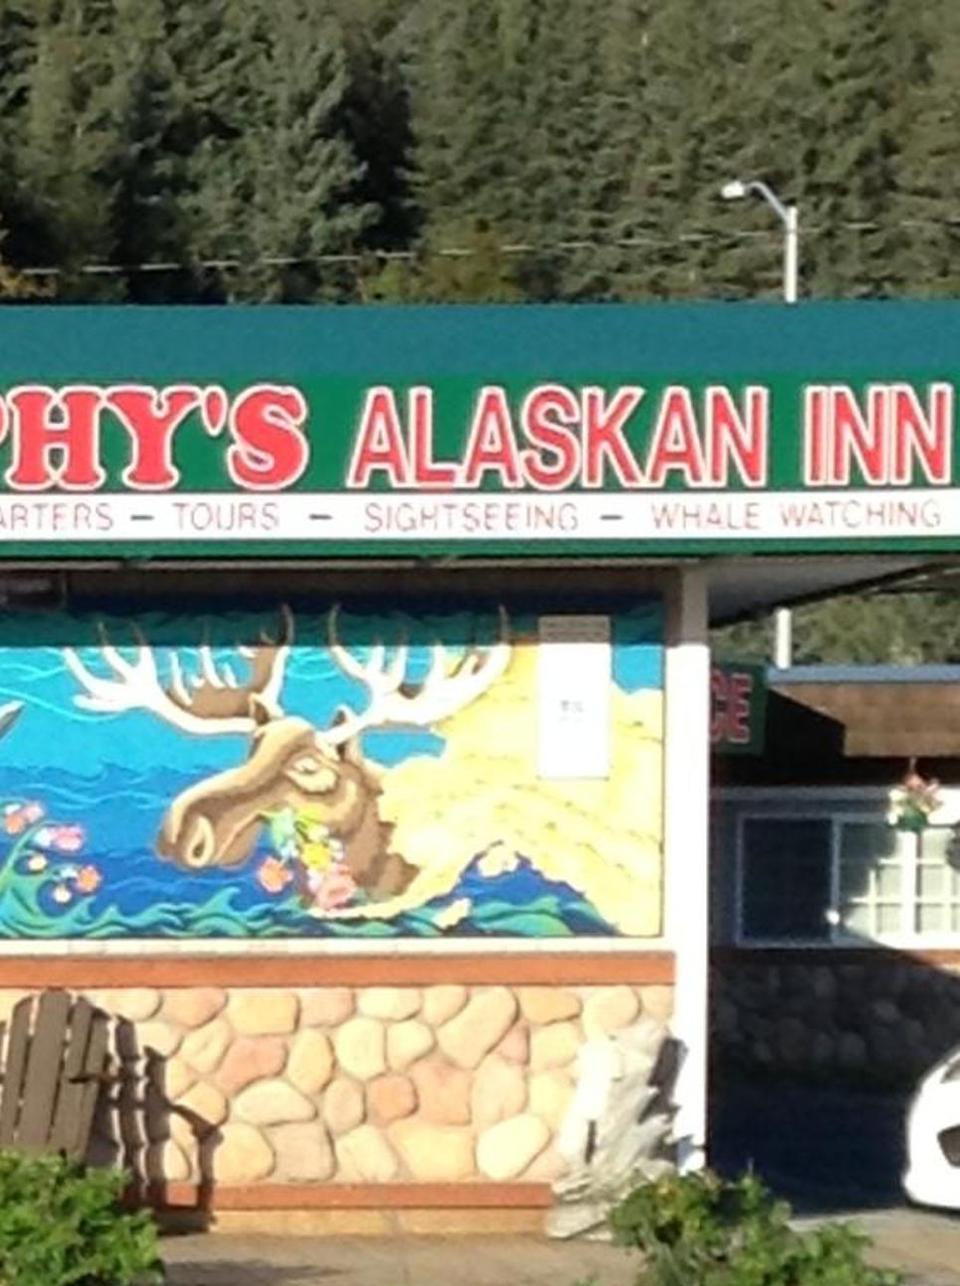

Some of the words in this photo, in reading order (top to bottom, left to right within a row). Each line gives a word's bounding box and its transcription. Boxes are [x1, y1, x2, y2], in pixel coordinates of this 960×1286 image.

[345, 384, 769, 491] ALASKAN
[802, 383, 954, 487] INN
[171, 502, 280, 532] TOURS
[363, 501, 578, 532] SIGHTSEEING
[651, 501, 761, 531] WHALE
[778, 500, 941, 529] WATCHING
